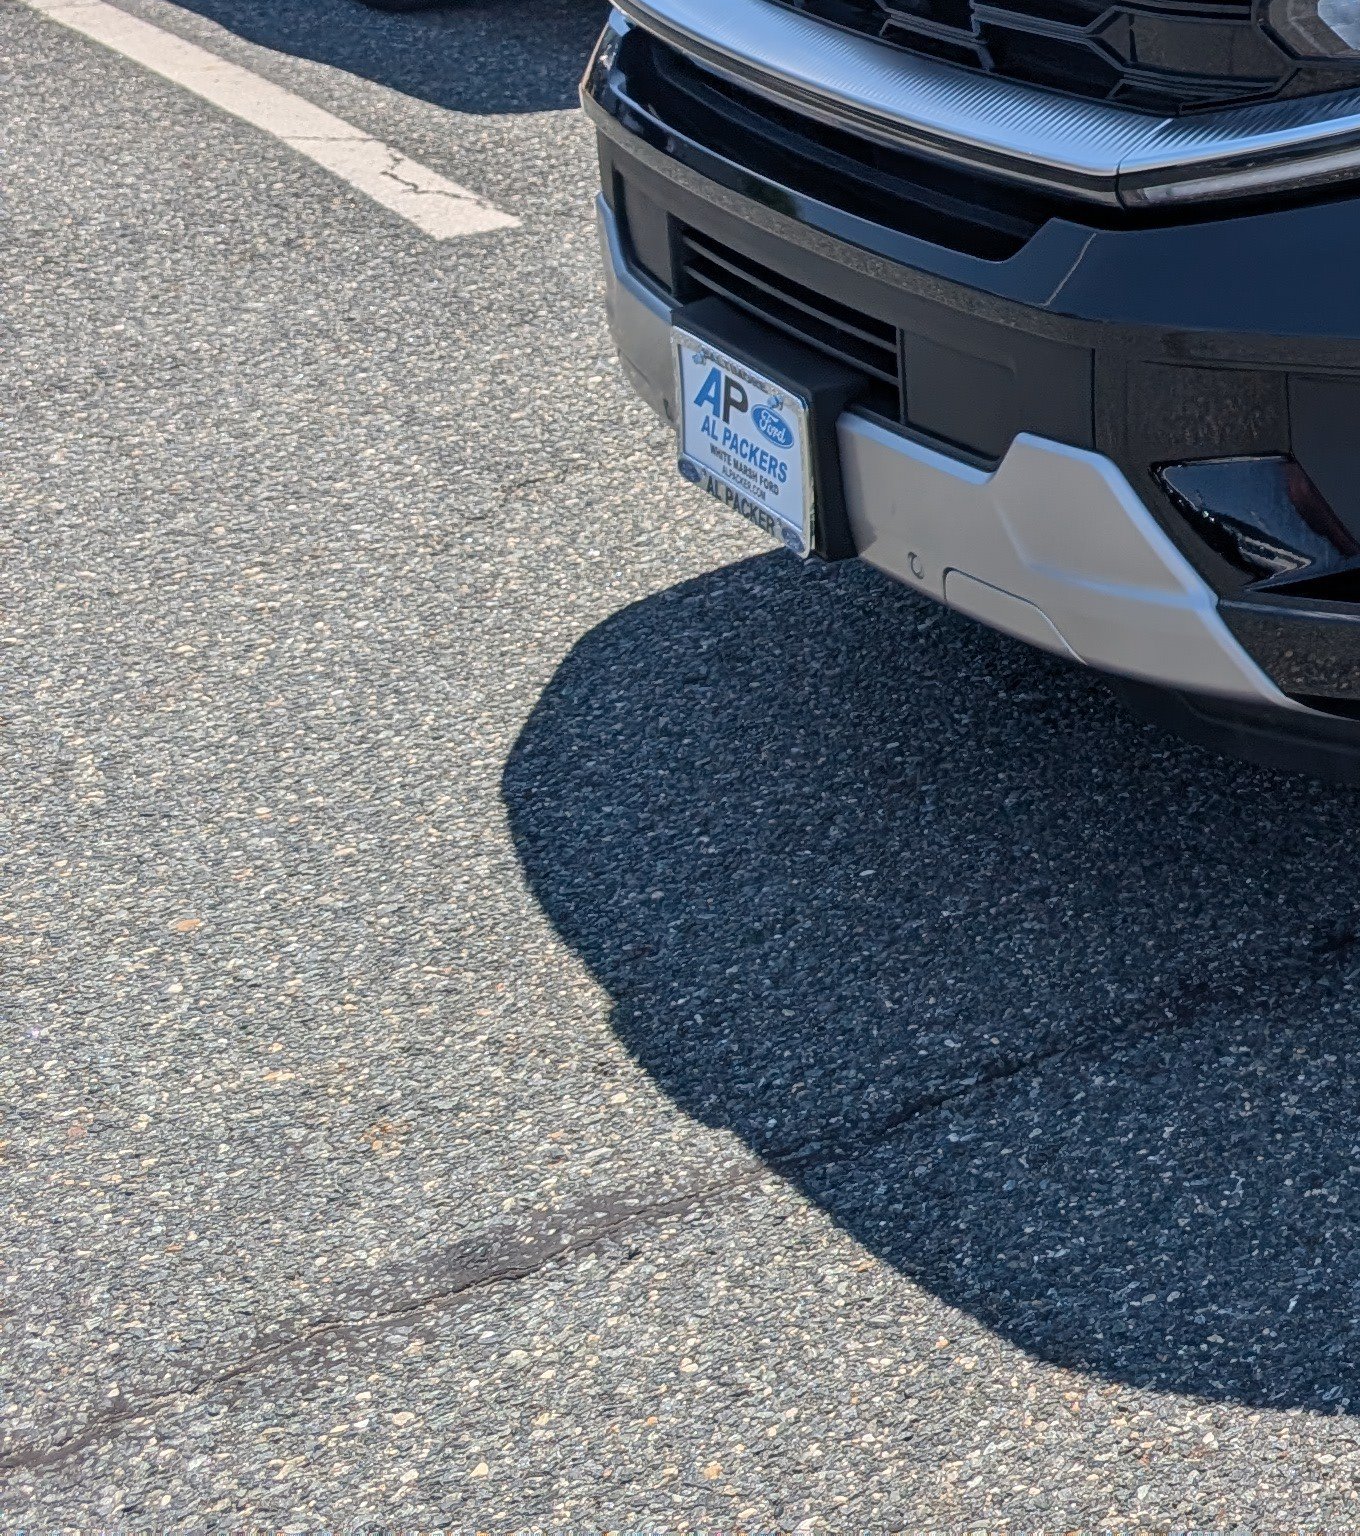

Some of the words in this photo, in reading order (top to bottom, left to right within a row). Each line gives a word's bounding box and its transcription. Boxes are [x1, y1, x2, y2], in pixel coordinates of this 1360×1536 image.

[693, 366, 748, 424] AP
[701, 415, 718, 441] AL
[722, 427, 788, 484] PACKERS
[759, 409, 786, 444] Ford
[760, 475, 779, 496] FORD
